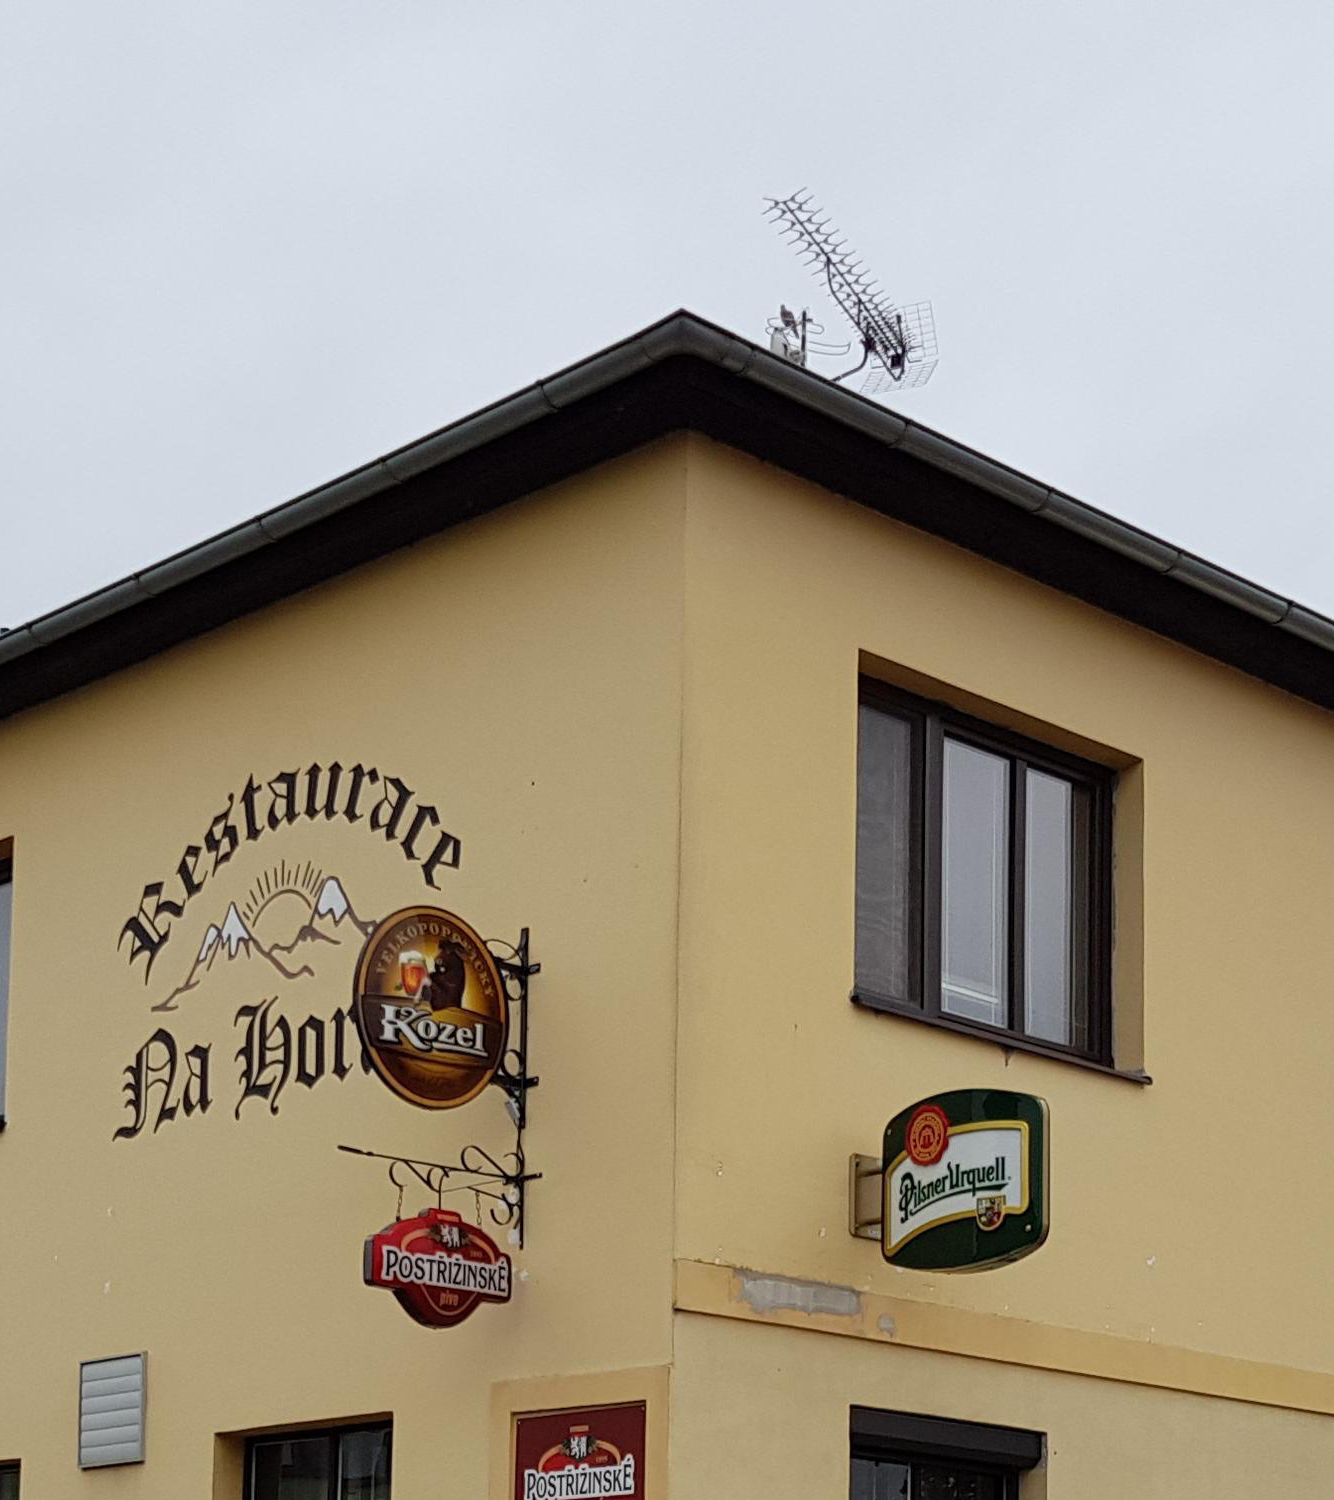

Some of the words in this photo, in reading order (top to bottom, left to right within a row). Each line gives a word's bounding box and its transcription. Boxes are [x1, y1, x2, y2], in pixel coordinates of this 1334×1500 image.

[117, 760, 462, 986] Restaurace
[379, 1004, 487, 1054] Kozel
[112, 1027, 213, 1142] Na
[234, 995, 371, 1121] Hor
[898, 1171, 950, 1224] Pilsner
[947, 1156, 1006, 1197] Urquell
[384, 1249, 507, 1293] POSTŘIŽINSKÉ
[526, 1457, 633, 1499] POSTŘIŽINSKÉ
